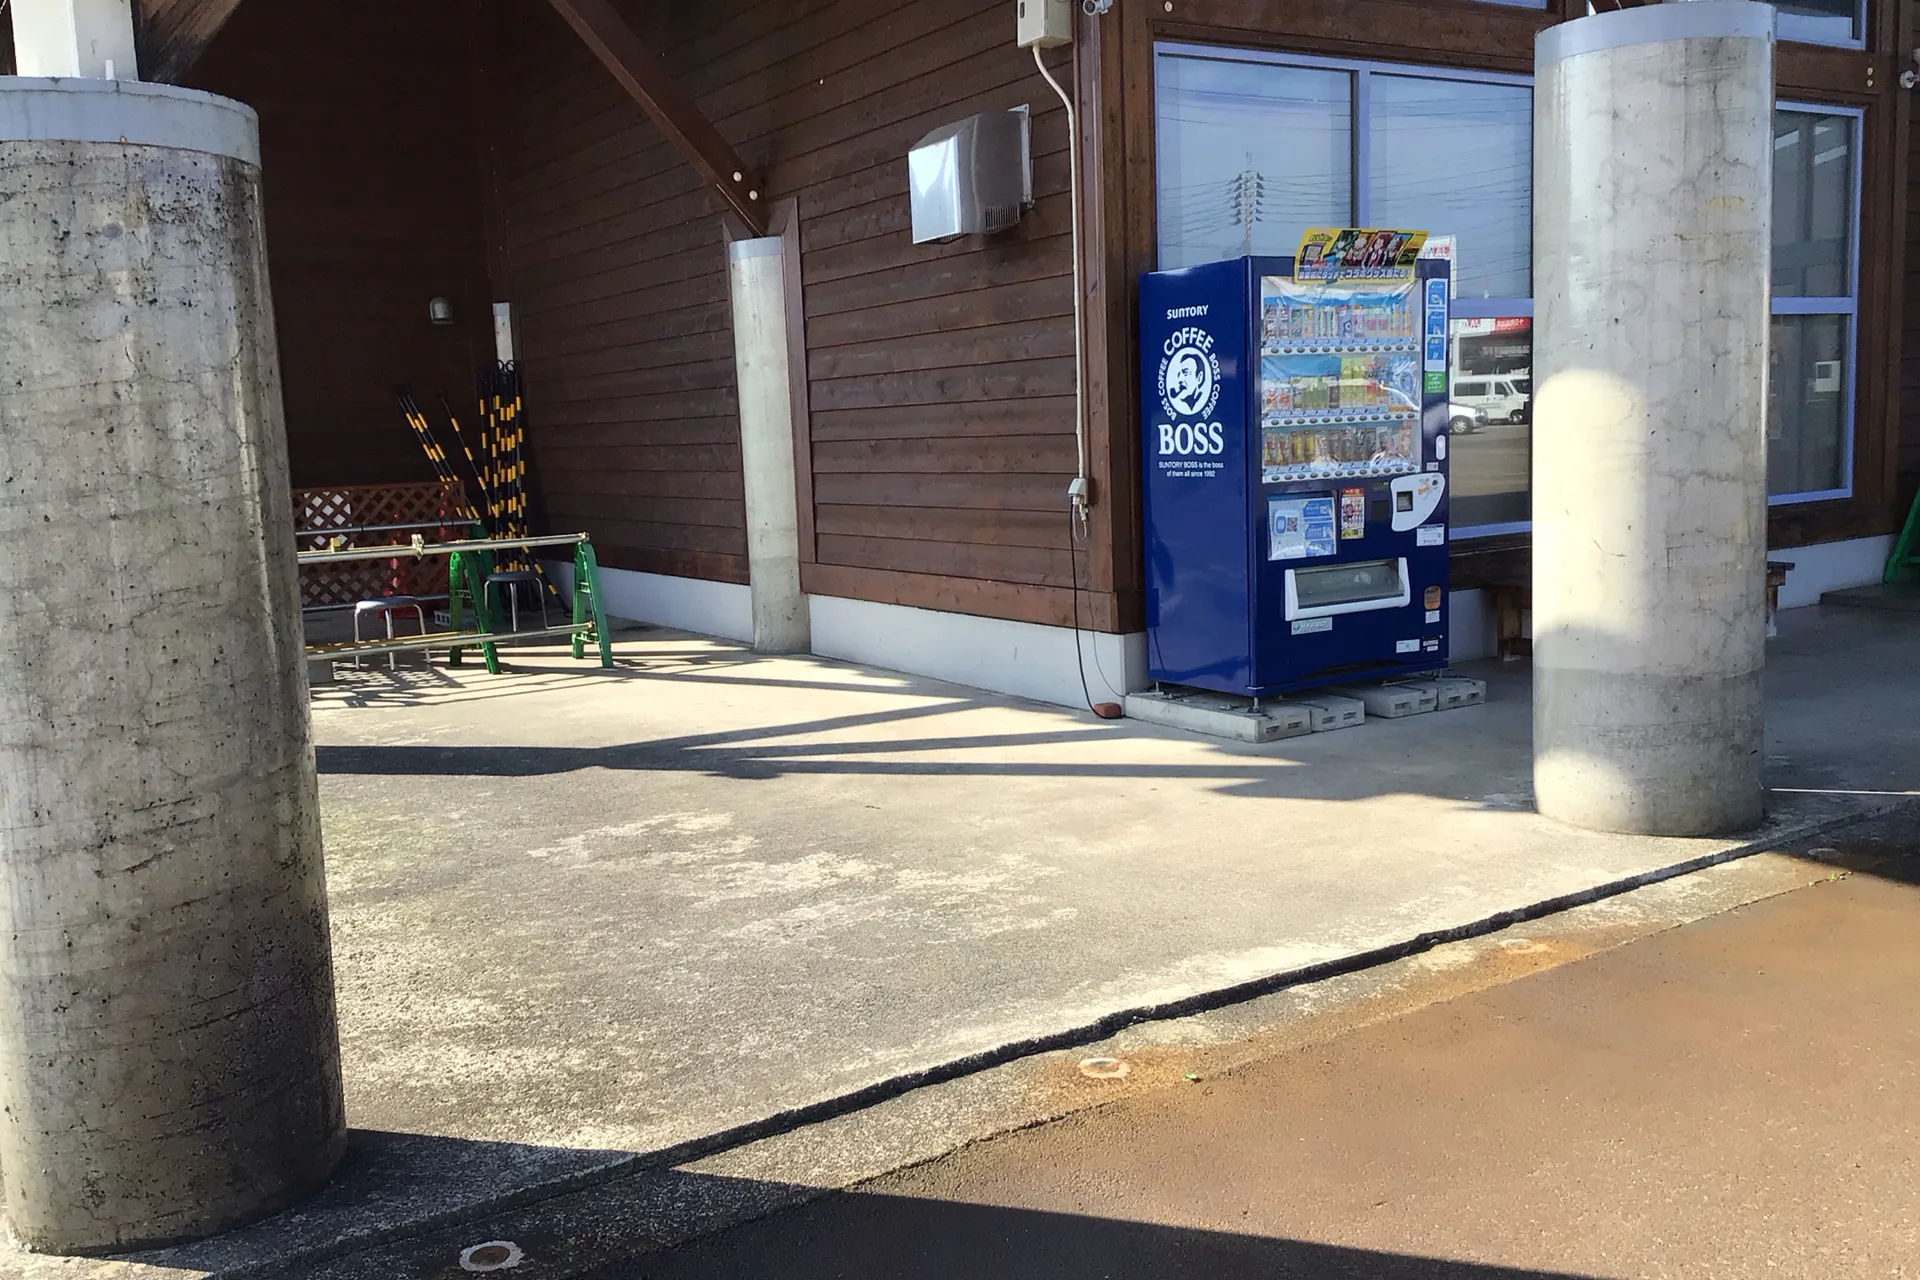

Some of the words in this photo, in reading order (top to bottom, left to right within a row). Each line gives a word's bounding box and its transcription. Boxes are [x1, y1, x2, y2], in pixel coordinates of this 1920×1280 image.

[1163, 326, 1215, 356] COFFEE
[1157, 356, 1169, 397] COFFEE
[1208, 352, 1221, 382] BOSS
[1160, 397, 1178, 421] BOSS
[1202, 383, 1221, 420] COFFEE
[1157, 421, 1224, 455] BOSS
[1158, 461, 1183, 469] SUNTORY
[1183, 461, 1198, 469] BOSS
[1203, 461, 1212, 469] the
[1211, 461, 1224, 469] boss
[1190, 470, 1203, 478] since
[1203, 470, 1216, 478] 1992
